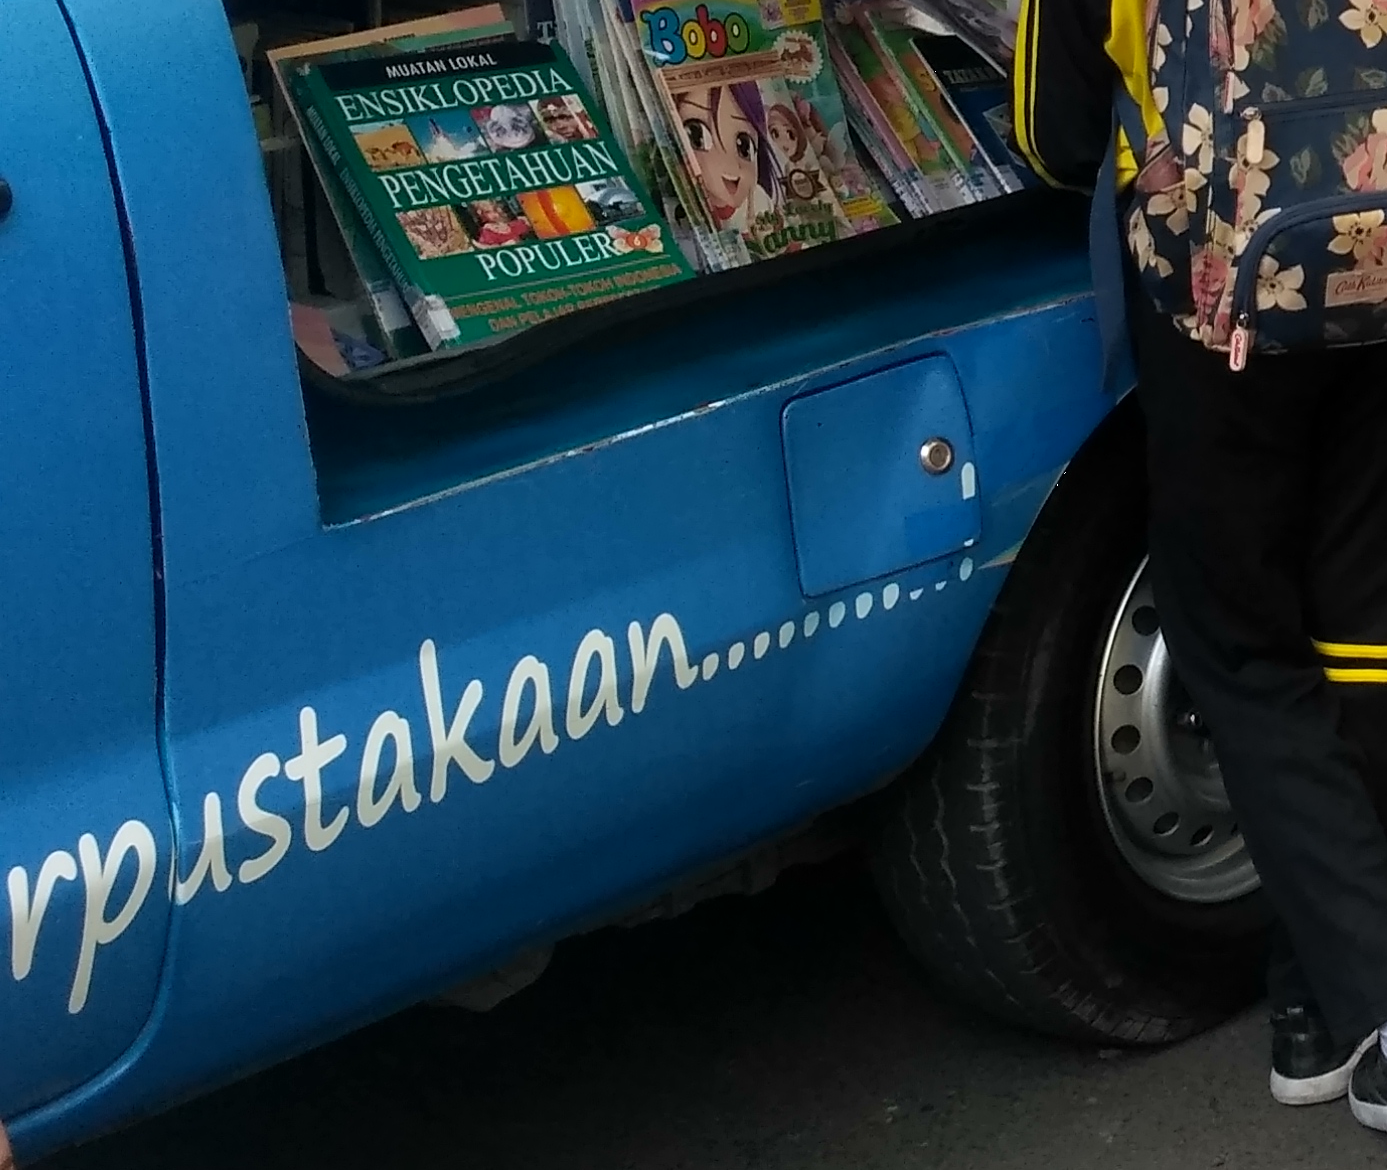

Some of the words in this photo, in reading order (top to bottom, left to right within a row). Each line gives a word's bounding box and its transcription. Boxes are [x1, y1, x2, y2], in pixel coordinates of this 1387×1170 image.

[641, 4, 751, 68] Bobo
[335, 66, 573, 122] ENSIKLOPEDIA
[385, 59, 447, 80] MUATAN
[449, 52, 498, 72] LOKAL
[377, 141, 620, 209] PENGETAHUAN
[474, 233, 622, 282] POPULER
